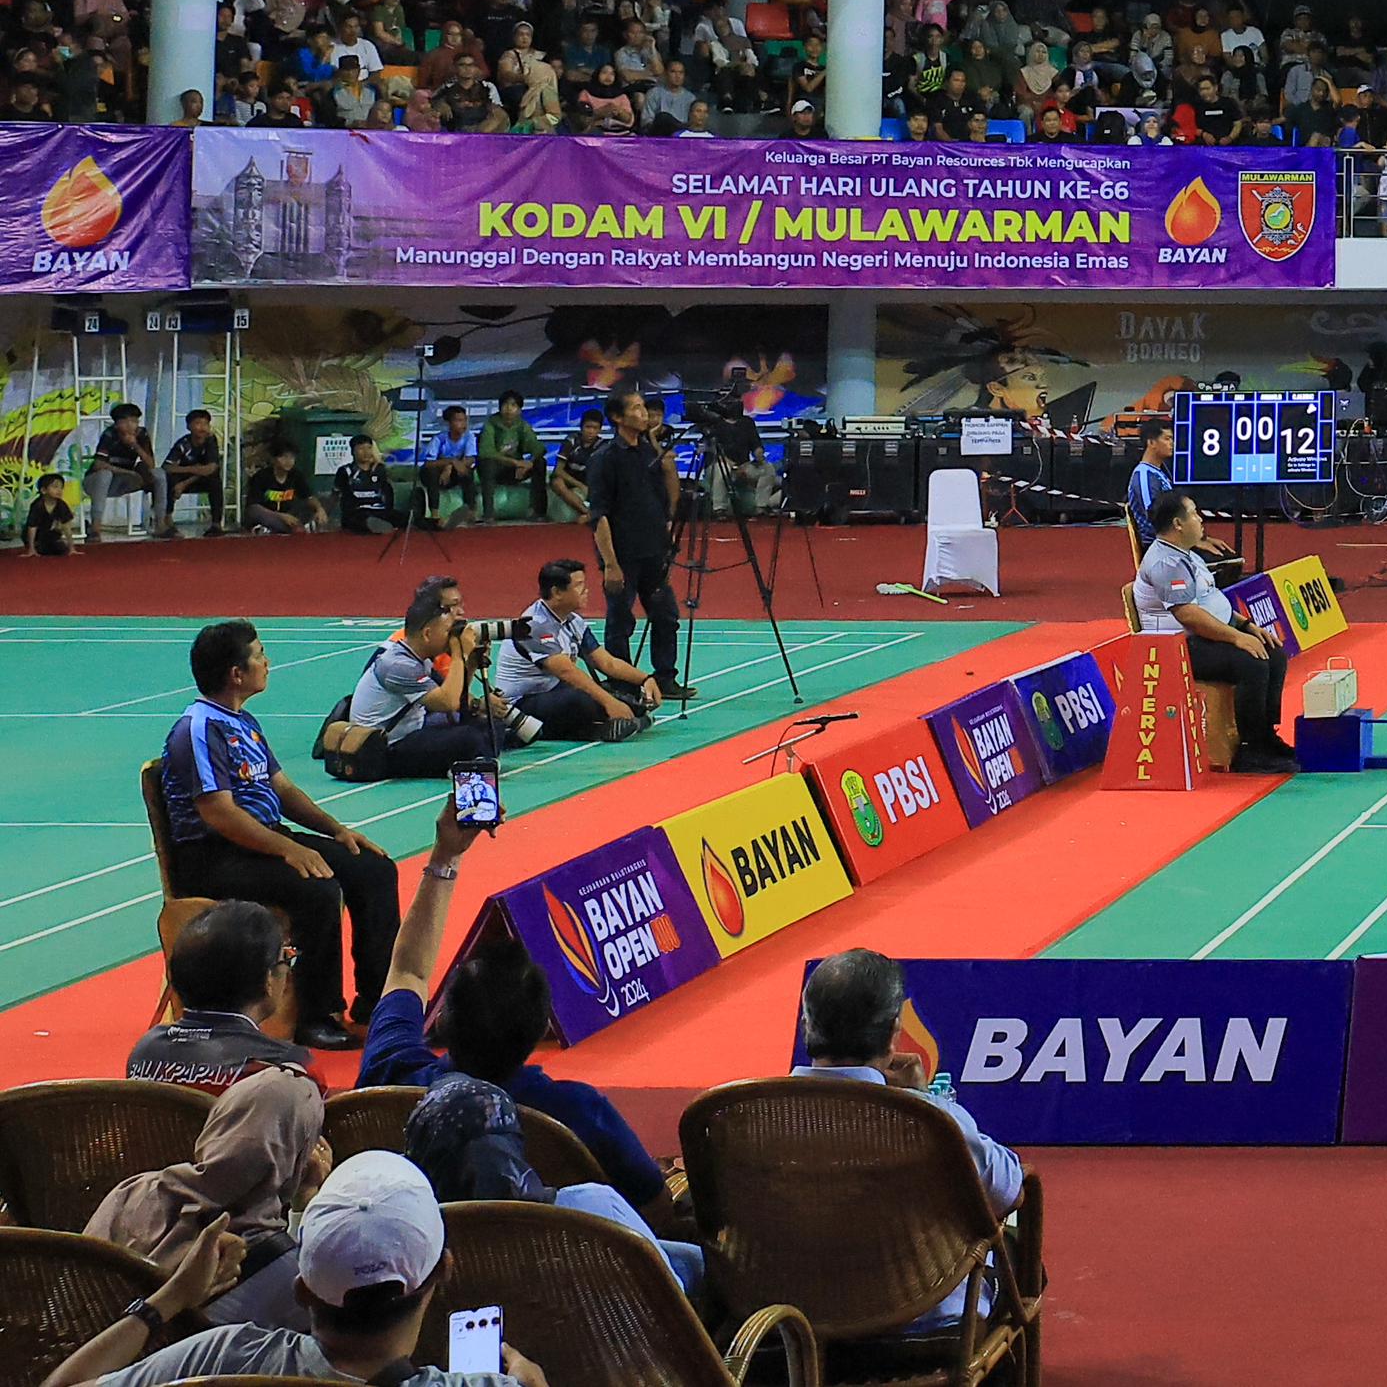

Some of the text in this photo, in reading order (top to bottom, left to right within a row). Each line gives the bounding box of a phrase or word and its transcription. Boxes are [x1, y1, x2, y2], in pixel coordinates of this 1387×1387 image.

[765, 151, 1130, 172] Keluarga Besar PT Bayan Resources Tbk Mengucapkan
[672, 174, 1128, 200] SELAMAT HARI ULANG TAHUN KE-66
[1242, 173, 1312, 182] MULAWARMAN
[480, 203, 663, 239] KODAM
[678, 206, 727, 240] VI
[775, 207, 1130, 244] MULAWARMAN
[32, 250, 129, 273] BAYAN
[396, 247, 1128, 272] Manunggal Dengan Rakyat Membangun Negeri Menuju Indonesia Emas
[1158, 248, 1227, 263] BAYAN
[236, 315, 247, 327] 15
[1126, 343, 1200, 363] BORNEO
[1202, 429, 1220, 456] 8
[1236, 417, 1273, 441] 0 0
[1280, 428, 1316, 455] 12
[1300, 577, 1331, 617] PBSI
[1055, 683, 1106, 734] PBSI
[1136, 648, 1160, 780] INTERVAL
[972, 713, 1015, 760] BAYAN
[874, 756, 940, 824] PBSI
[730, 816, 821, 898] BAYAN
[584, 871, 664, 942] BAYAN
[620, 978, 650, 1007] 2024
[959, 1018, 1287, 1082] BAYAN
